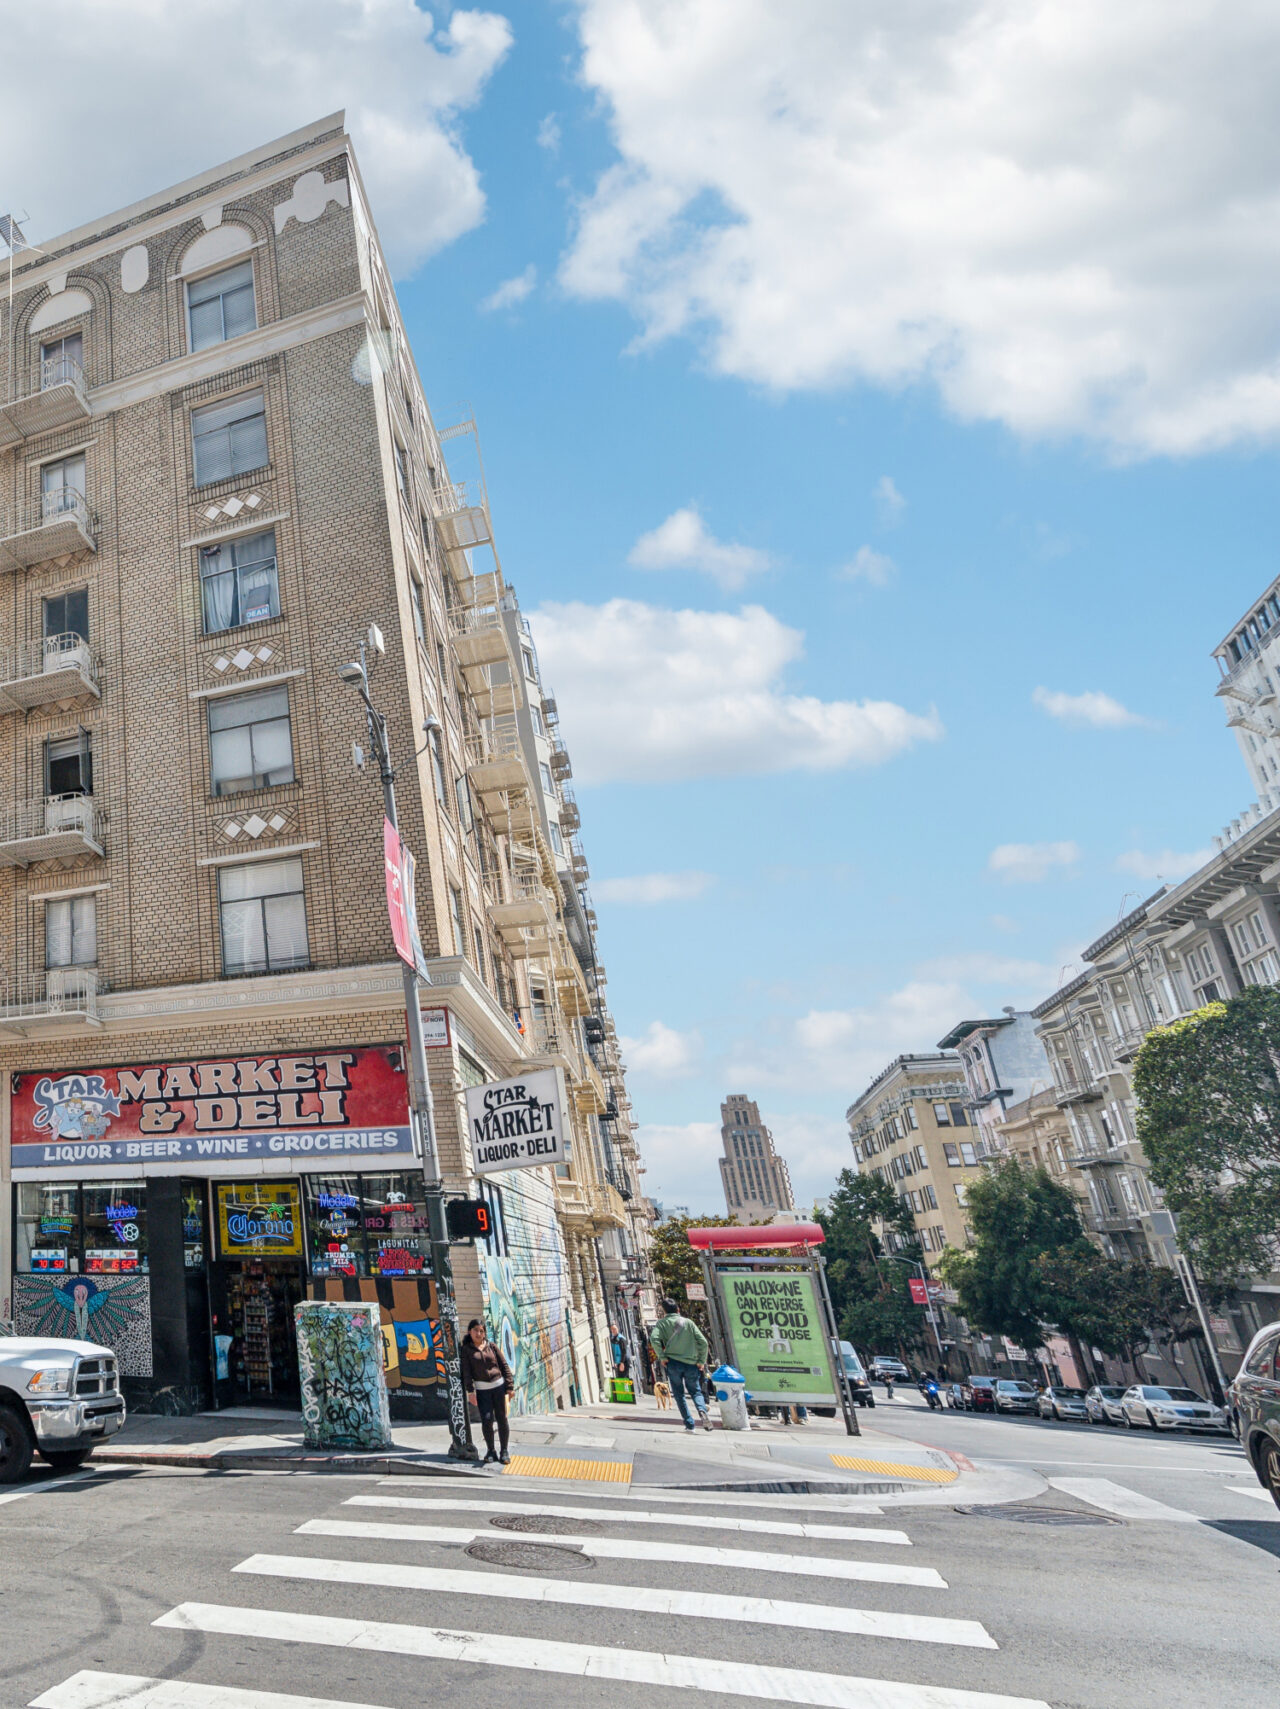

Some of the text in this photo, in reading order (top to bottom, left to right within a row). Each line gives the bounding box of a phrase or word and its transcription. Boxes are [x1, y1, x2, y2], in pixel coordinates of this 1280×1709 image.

[117, 1053, 357, 1103] MARKET
[33, 1073, 108, 1128] STAR
[139, 1091, 350, 1134] & DELI
[483, 1085, 527, 1123] STAR
[474, 1103, 555, 1143] MARKET
[43, 1131, 399, 1162] LIQUOR BEER WINE GROCERIES
[477, 1136, 557, 1164] LIQUOR DELI
[106, 1205, 138, 1219] Modelo
[319, 1193, 357, 1208] Modelo
[227, 1214, 294, 1239] Corona
[477, 1208, 489, 1231] 9
[324, 1251, 356, 1259] TRUMER
[378, 1239, 419, 1249] LAGUNITAS
[733, 1279, 803, 1297] NALOXONE
[736, 1297, 805, 1312] CAN REVERSE
[739, 1311, 809, 1328] OPIOID
